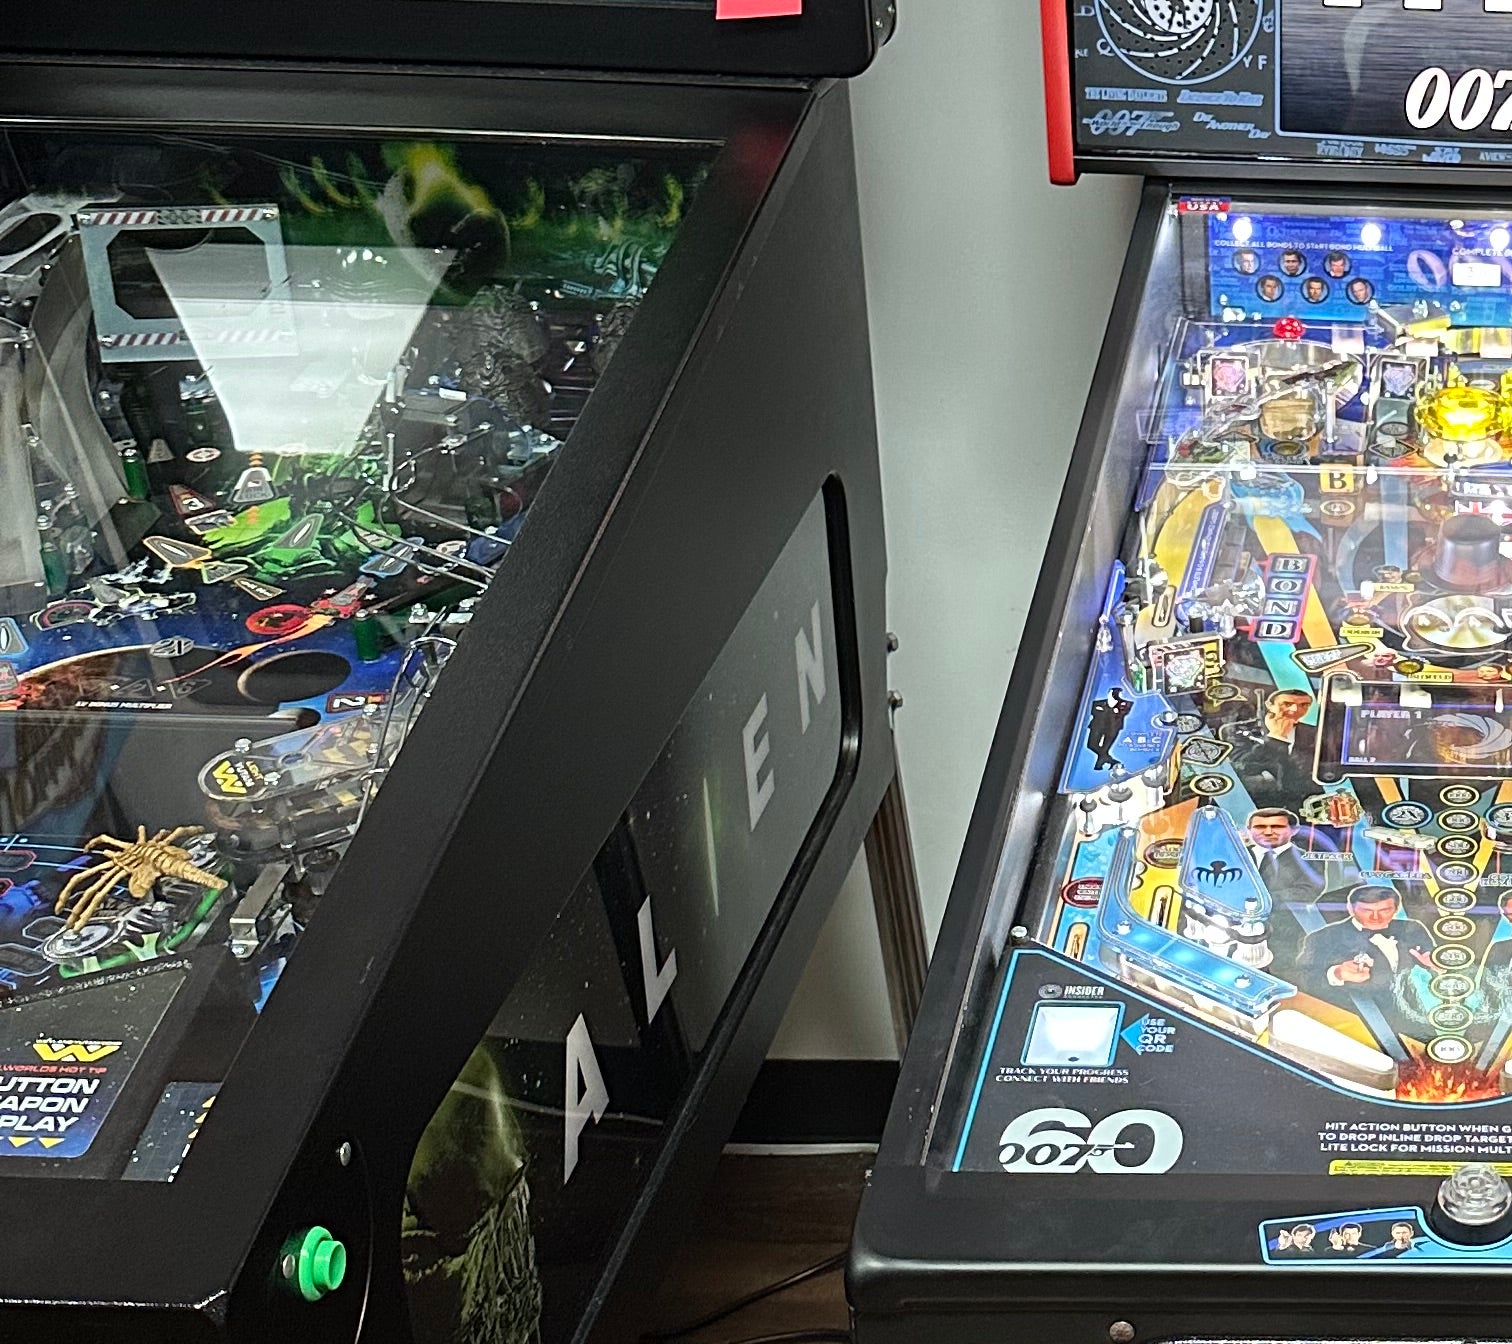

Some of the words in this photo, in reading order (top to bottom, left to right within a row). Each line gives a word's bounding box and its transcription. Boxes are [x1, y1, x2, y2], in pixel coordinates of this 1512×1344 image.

[1361, 709, 1411, 719] PLAYER
[1414, 710, 1422, 719] 1
[1064, 985, 1104, 996] INSIDER
[1141, 1026, 1176, 1034] YOUR
[1137, 1034, 1167, 1044] QR
[1136, 1044, 1174, 1053] CODE
[1325, 1122, 1347, 1130] HIT
[1349, 1123, 1399, 1131] ACTION
[1402, 1123, 1456, 1132] BUTTON
[1458, 1124, 1500, 1132] WHEN
[1000, 1107, 1184, 1174] 60
[1318, 1132, 1336, 1140] TO
[1339, 1133, 1376, 1141] DROP
[1378, 1134, 1422, 1142] INLINE
[1424, 1134, 1462, 1142] DROP
[1320, 1143, 1348, 1152] LITE
[1350, 1144, 1387, 1152] LOCK
[1390, 1144, 1418, 1152] FOR
[1420, 1145, 1474, 1153] MISSION
[999, 1143, 1135, 1167] 007
